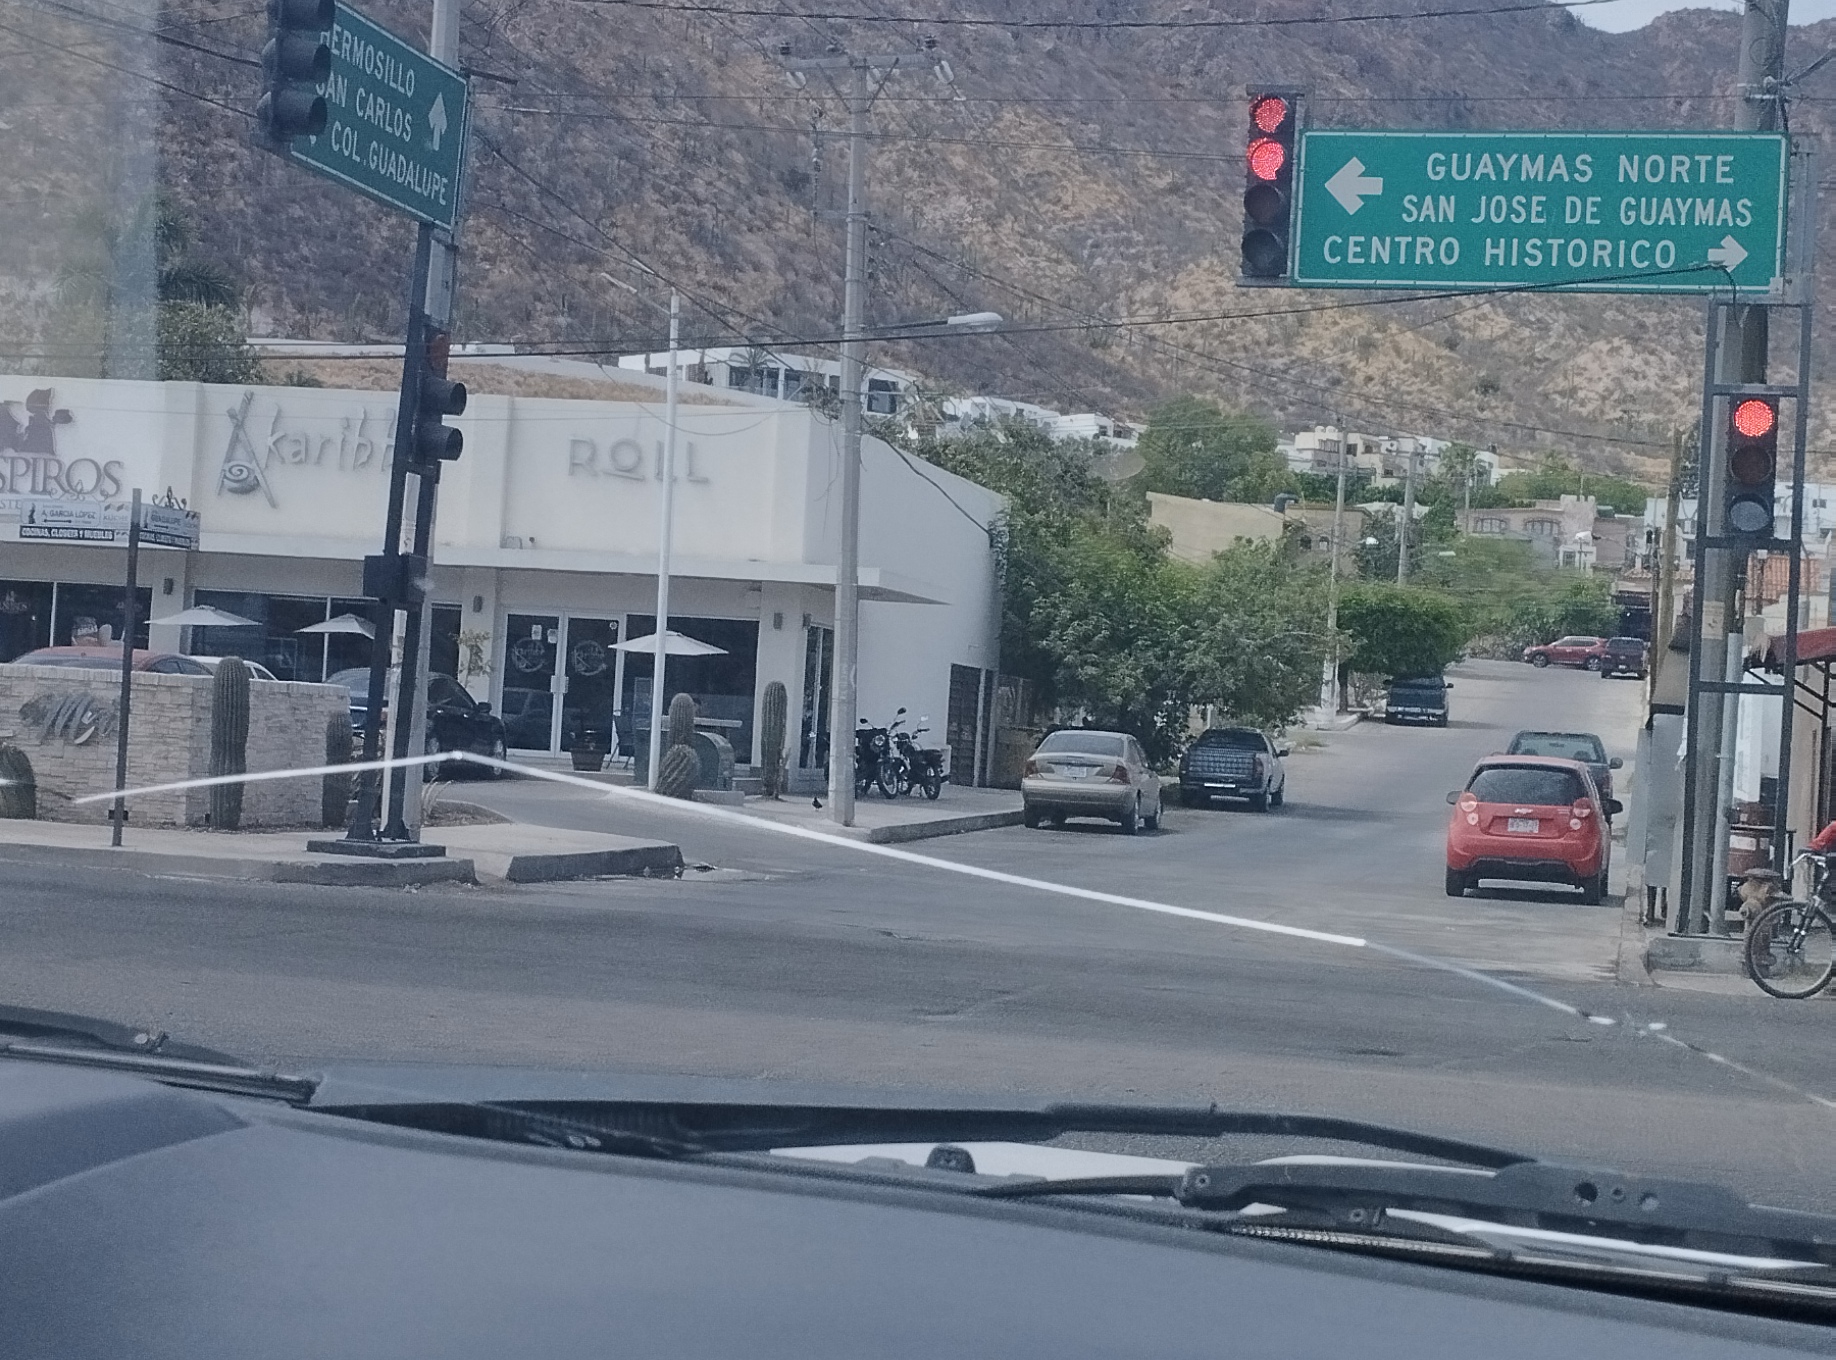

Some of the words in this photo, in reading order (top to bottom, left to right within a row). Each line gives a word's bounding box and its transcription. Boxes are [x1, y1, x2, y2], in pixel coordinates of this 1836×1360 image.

[356, 87, 412, 142] CARLOS
[1426, 152, 1593, 183] GUAYMAS
[1618, 154, 1735, 185] NORTE
[1401, 194, 1456, 224] SAN
[1471, 195, 1547, 225] JOSE
[1565, 196, 1602, 226] DE
[1620, 197, 1753, 228] GUAYMAS
[1323, 235, 1460, 265] CENTRO
[1484, 237, 1677, 270] HISTORICO
[568, 437, 710, 485] ROLL
